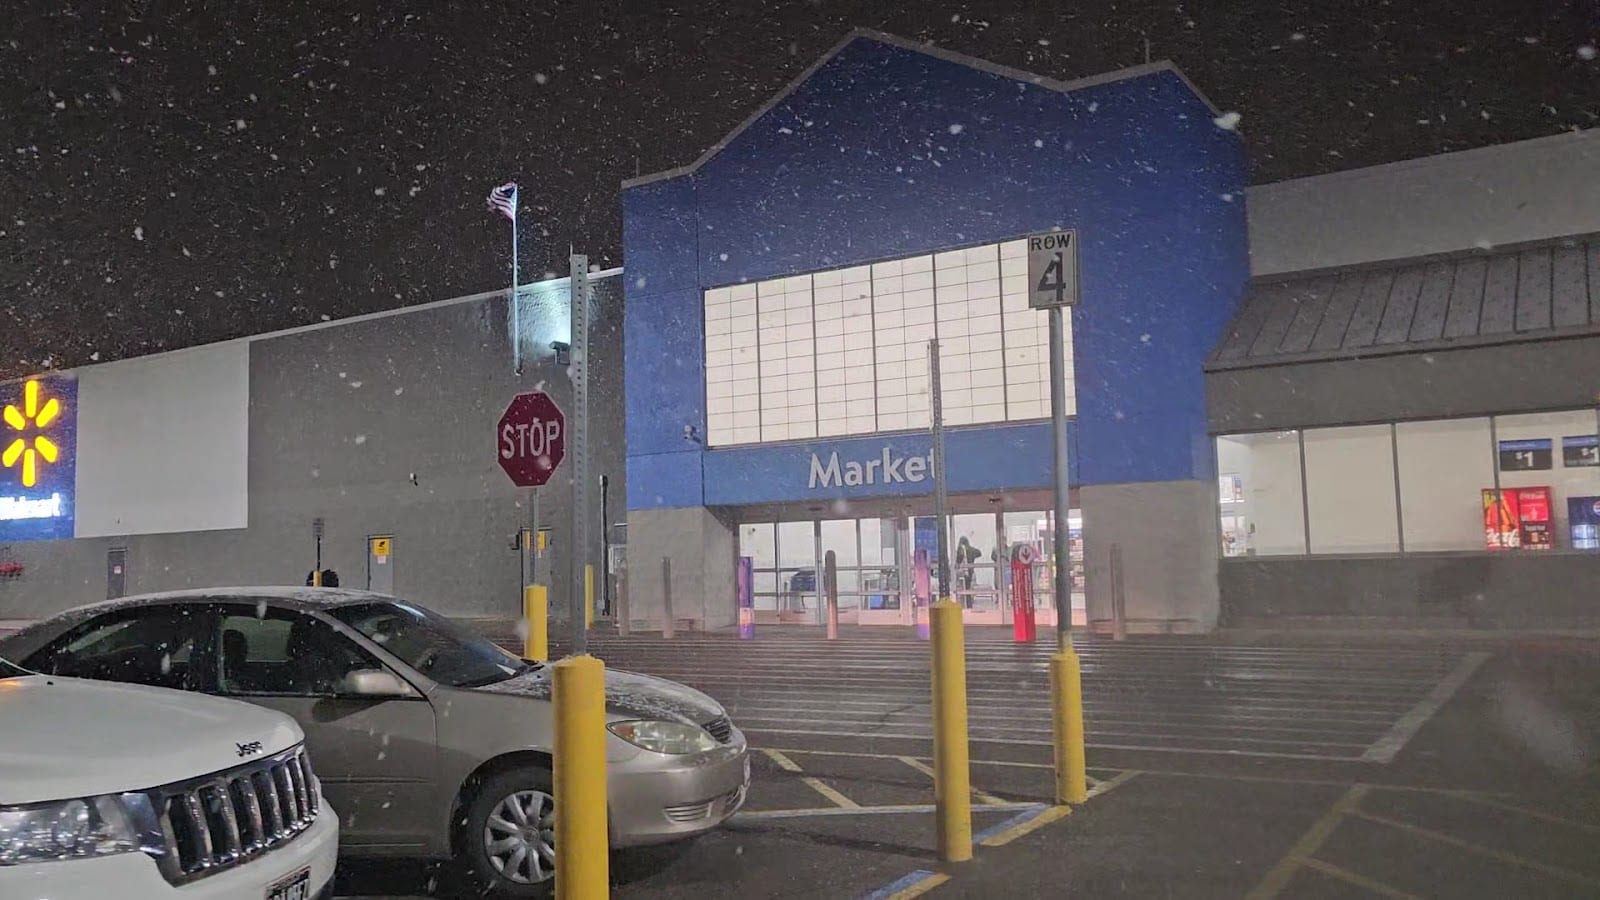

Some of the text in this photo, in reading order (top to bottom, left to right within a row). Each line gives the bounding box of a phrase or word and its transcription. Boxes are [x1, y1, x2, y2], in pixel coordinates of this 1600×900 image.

[1031, 234, 1070, 252] ROW
[1037, 251, 1066, 302] 4
[502, 419, 560, 460] STOP
